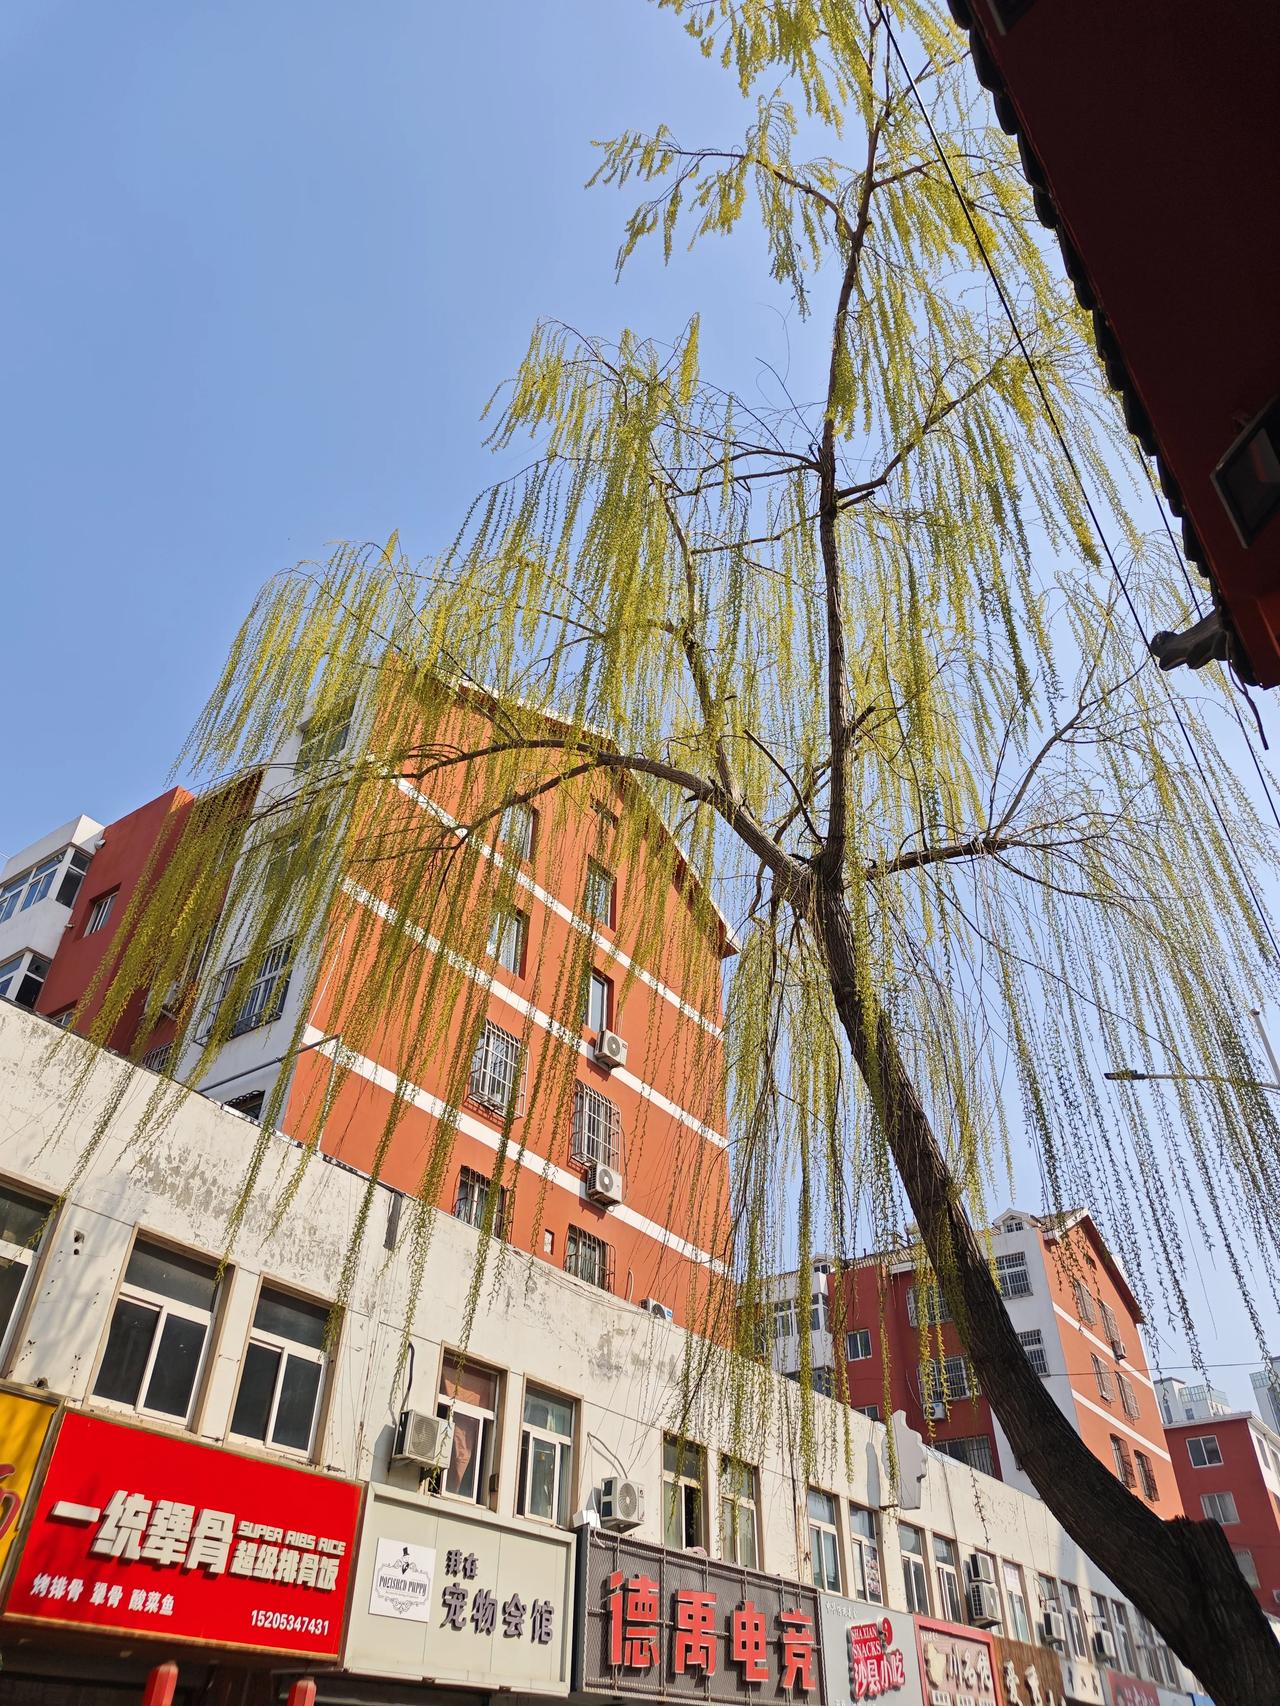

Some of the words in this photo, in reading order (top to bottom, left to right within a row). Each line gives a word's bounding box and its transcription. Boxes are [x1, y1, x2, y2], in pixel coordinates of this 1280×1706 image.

[237, 1520, 283, 1543] SUPER
[284, 1530, 317, 1550] RIBS
[317, 1537, 347, 1556] RICE
[229, 1540, 340, 1591] 超级排骨饭
[30, 1572, 84, 1602] 烤排骨
[128, 1588, 175, 1616] 酸菜鱼
[439, 1582, 555, 1645] 宠物会馆
[251, 1609, 329, 1637] 15205347431
[609, 1569, 817, 1690] 德禹电竞
[853, 1640, 882, 1659] SNACKS
[853, 1650, 905, 1698] 沙县小吃
